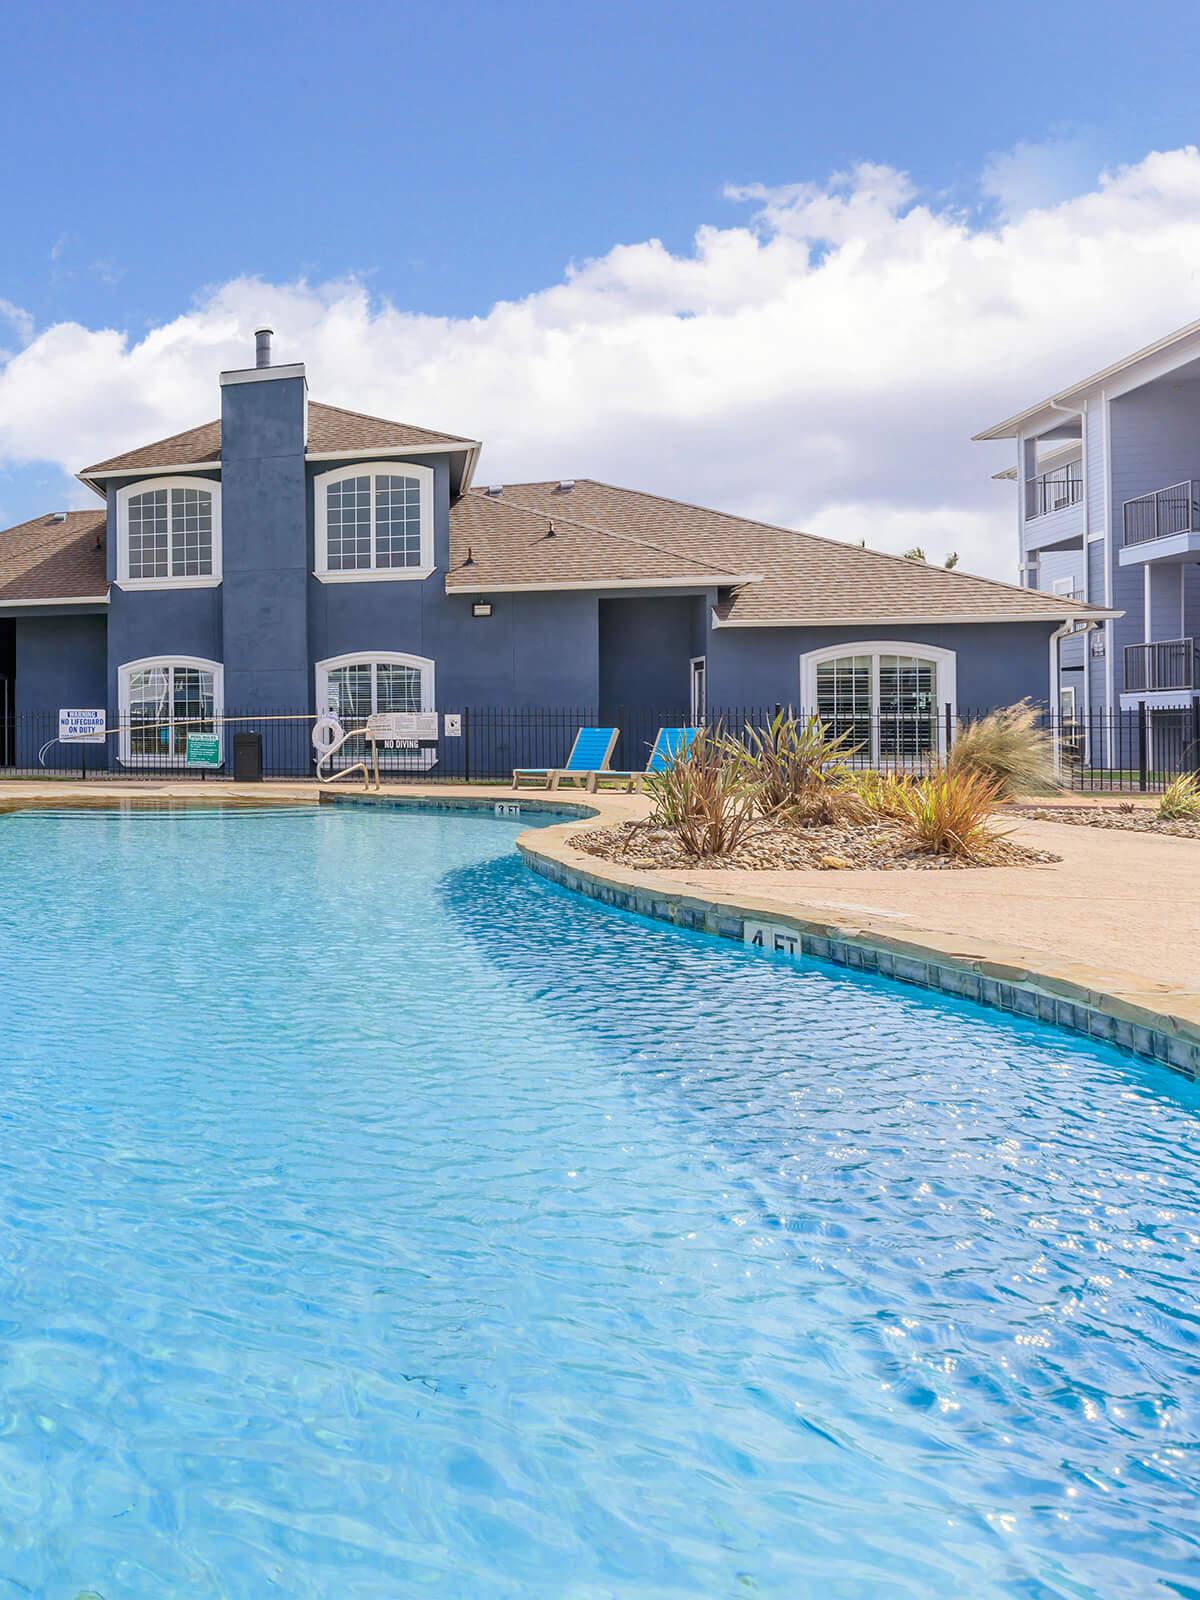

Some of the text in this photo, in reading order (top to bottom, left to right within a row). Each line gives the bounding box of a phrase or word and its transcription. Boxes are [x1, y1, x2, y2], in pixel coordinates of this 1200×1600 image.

[384, 740, 419, 748] NO DIVING
[752, 930, 798, 954] 4 FT
